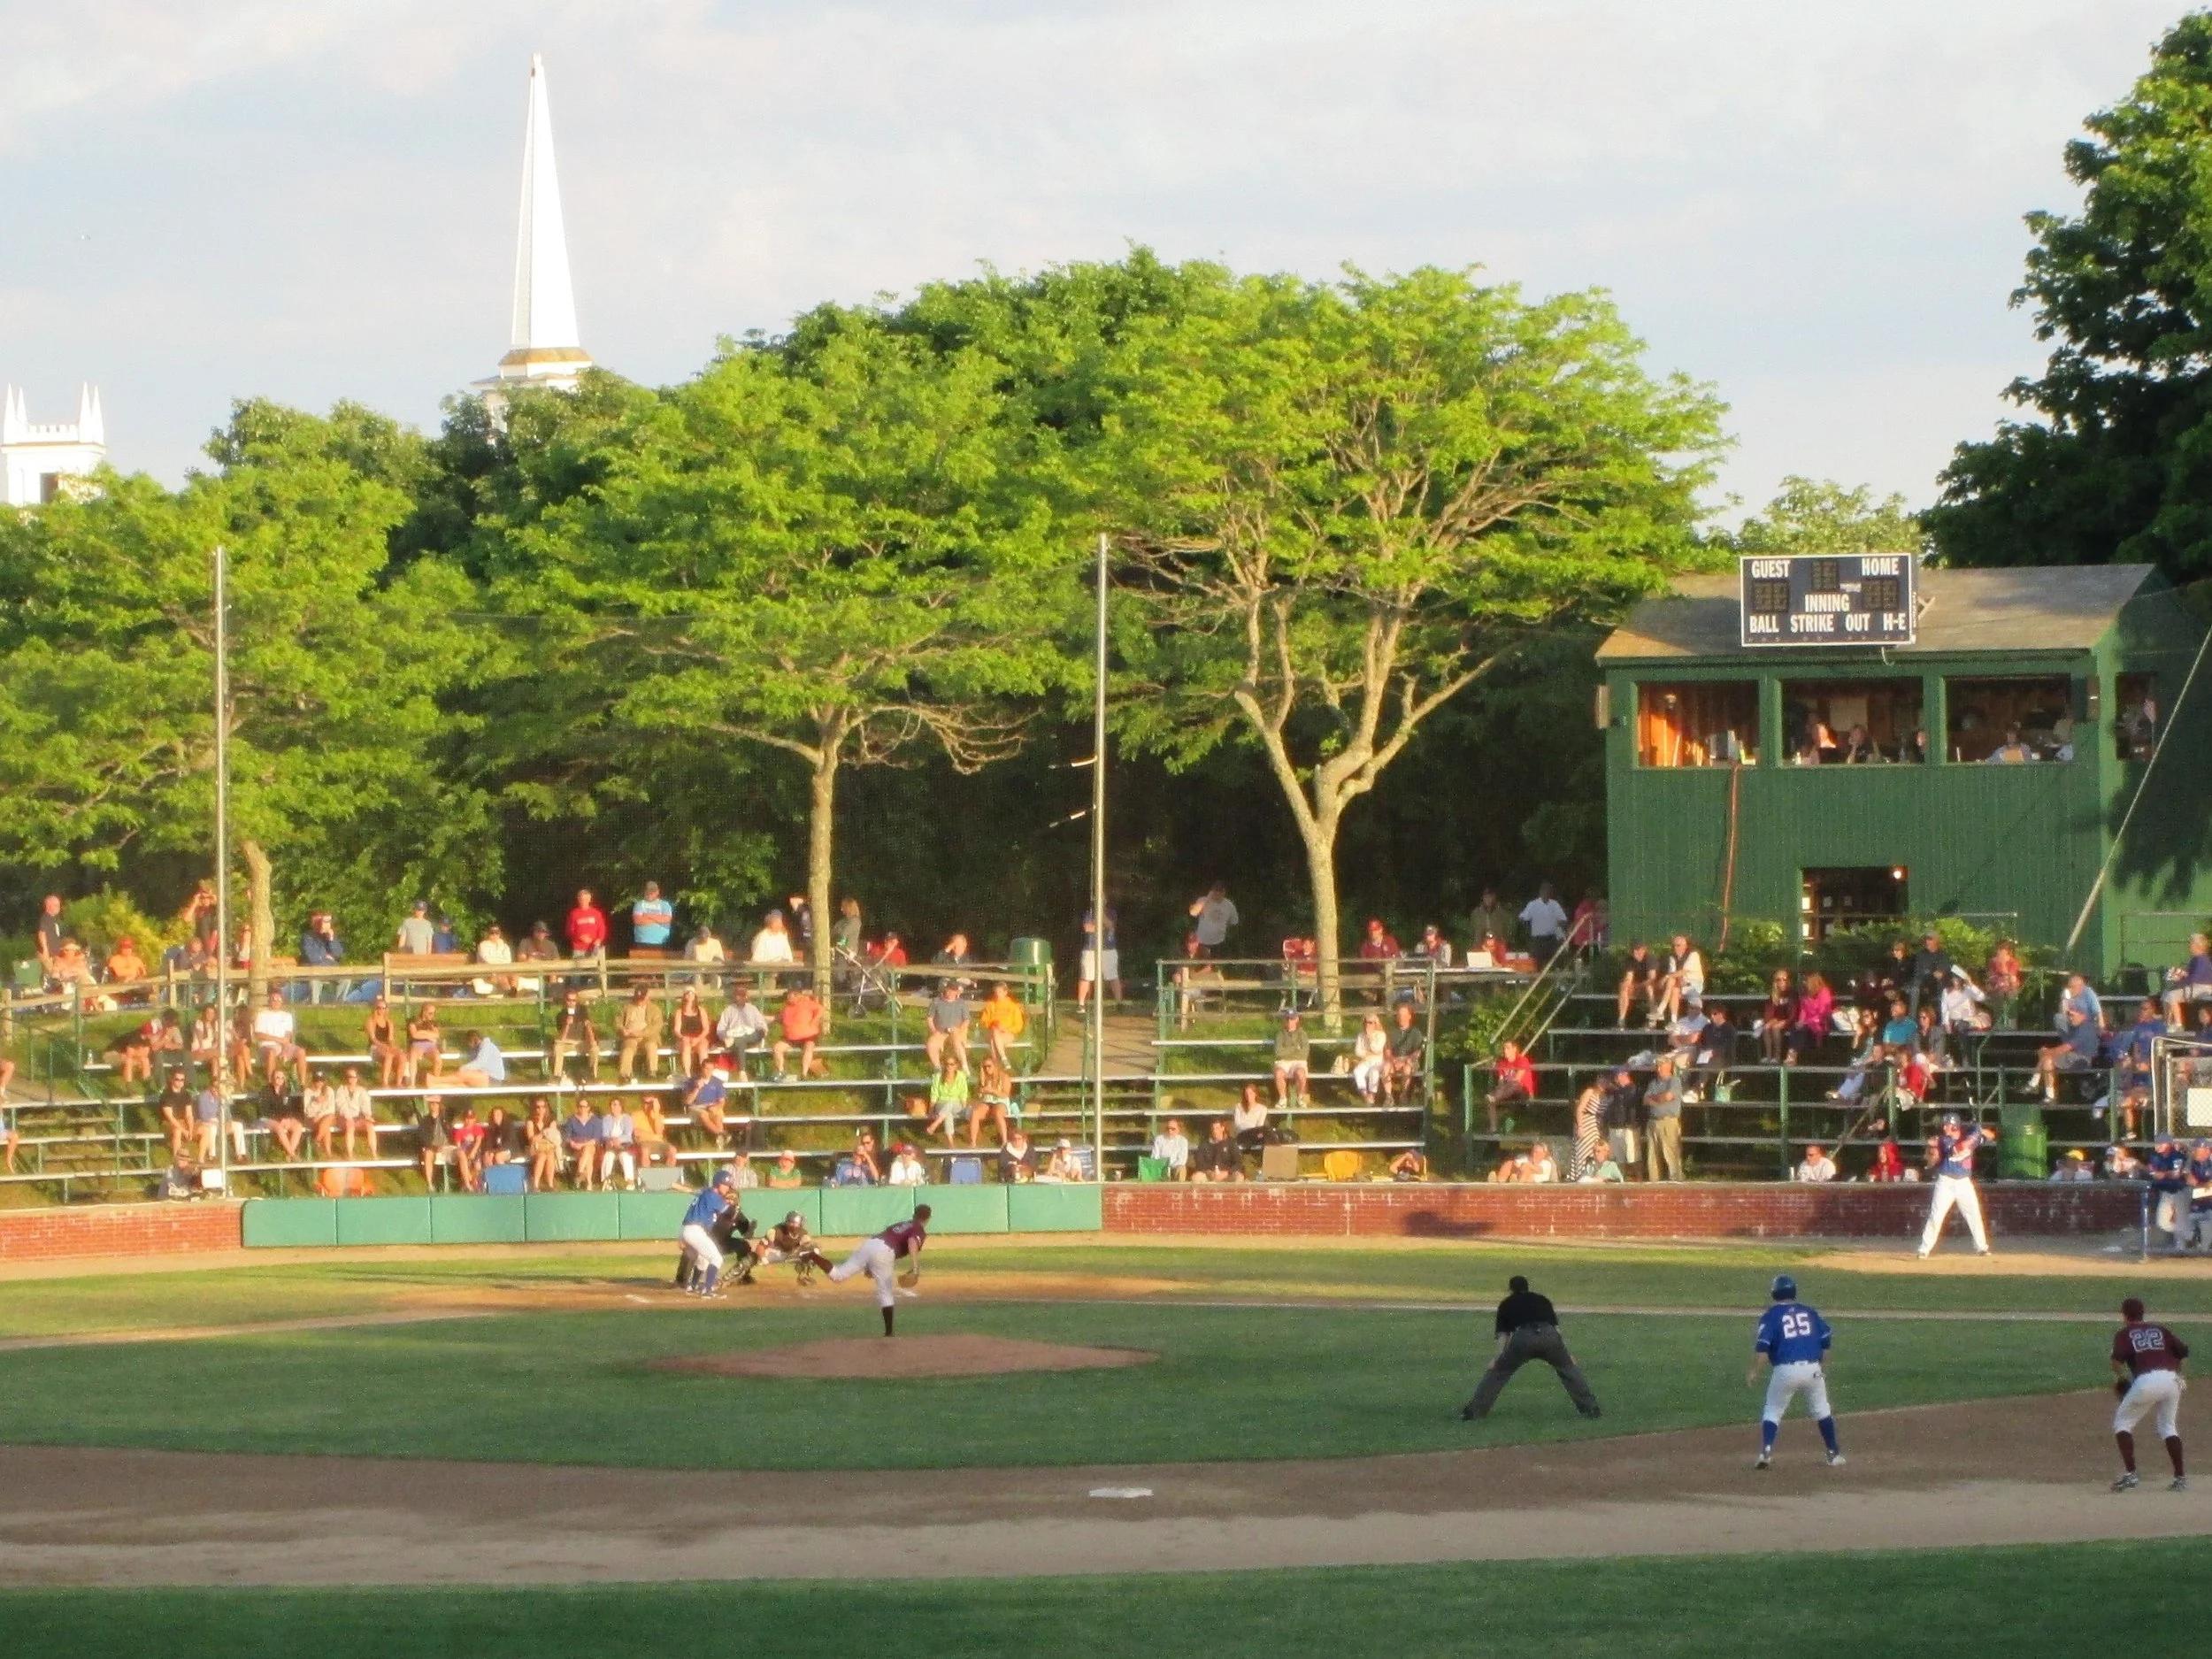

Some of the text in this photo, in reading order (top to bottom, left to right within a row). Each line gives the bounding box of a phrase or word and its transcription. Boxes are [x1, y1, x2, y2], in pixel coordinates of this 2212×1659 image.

[1751, 557, 1900, 579] GUEST HOME
[1805, 594, 1850, 612] INNING
[1749, 612, 1907, 634] BALL STRIKE OUT H-E
[1781, 1312, 1811, 1339] 25
[2129, 1328, 2165, 1353] 22
